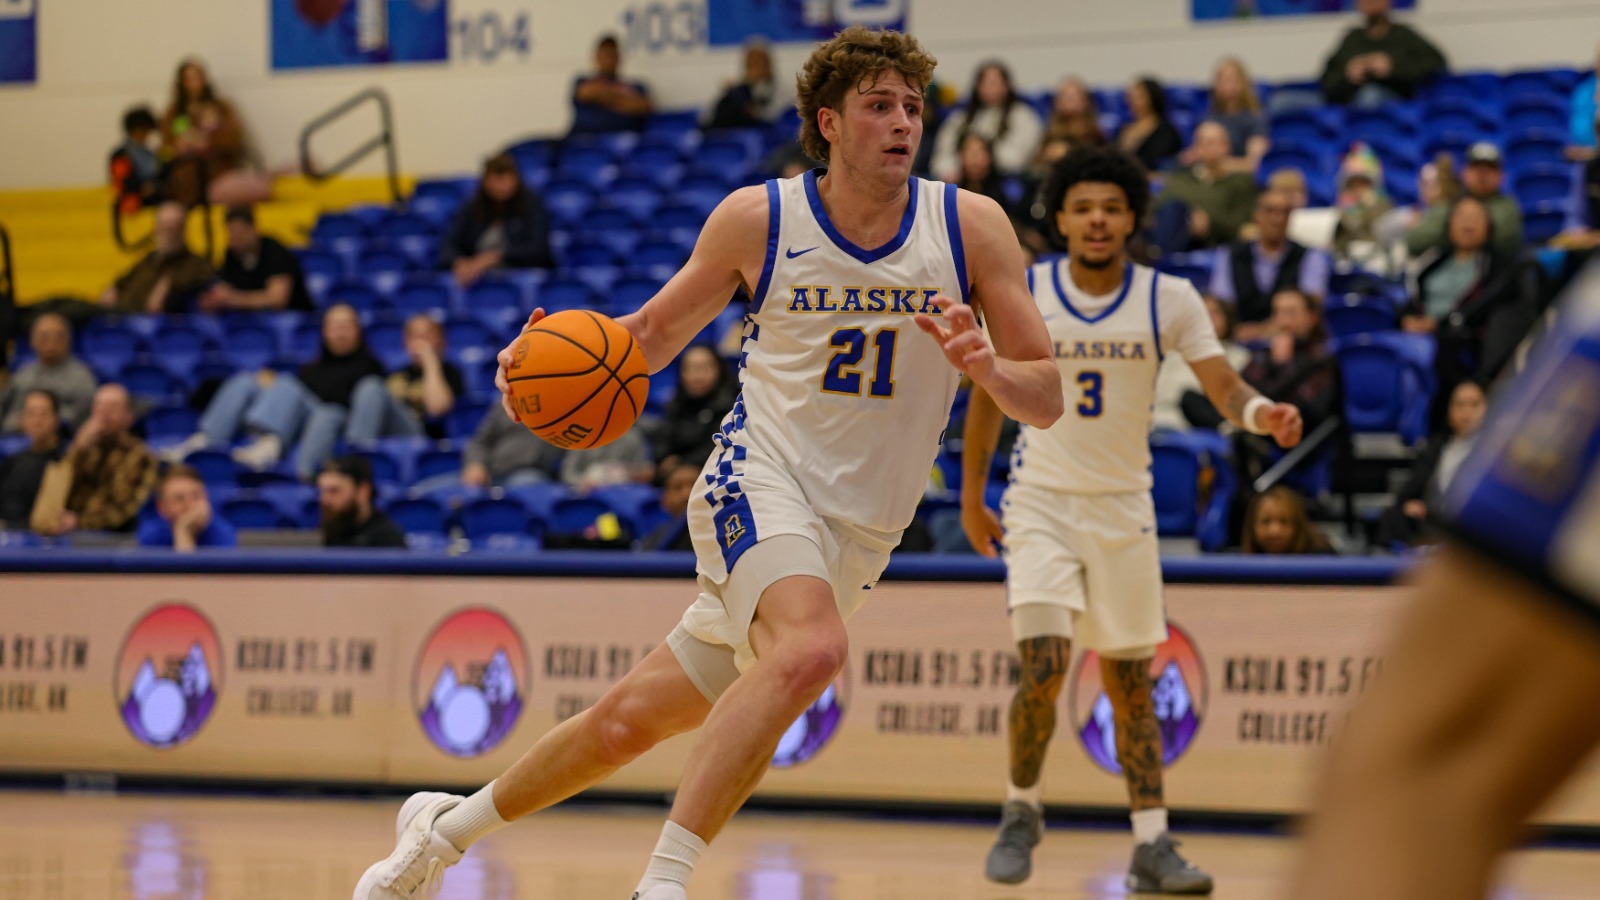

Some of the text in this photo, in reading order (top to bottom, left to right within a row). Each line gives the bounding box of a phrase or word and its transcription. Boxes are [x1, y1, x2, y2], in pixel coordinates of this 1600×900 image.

[453, 11, 530, 62] 104
[787, 285, 943, 316] ALASKA
[820, 325, 899, 400] 21
[1053, 340, 1147, 361] LASKA
[1075, 368, 1105, 419] 3
[1223, 655, 1287, 693] KSUA
[1297, 656, 1350, 695] 91.5
